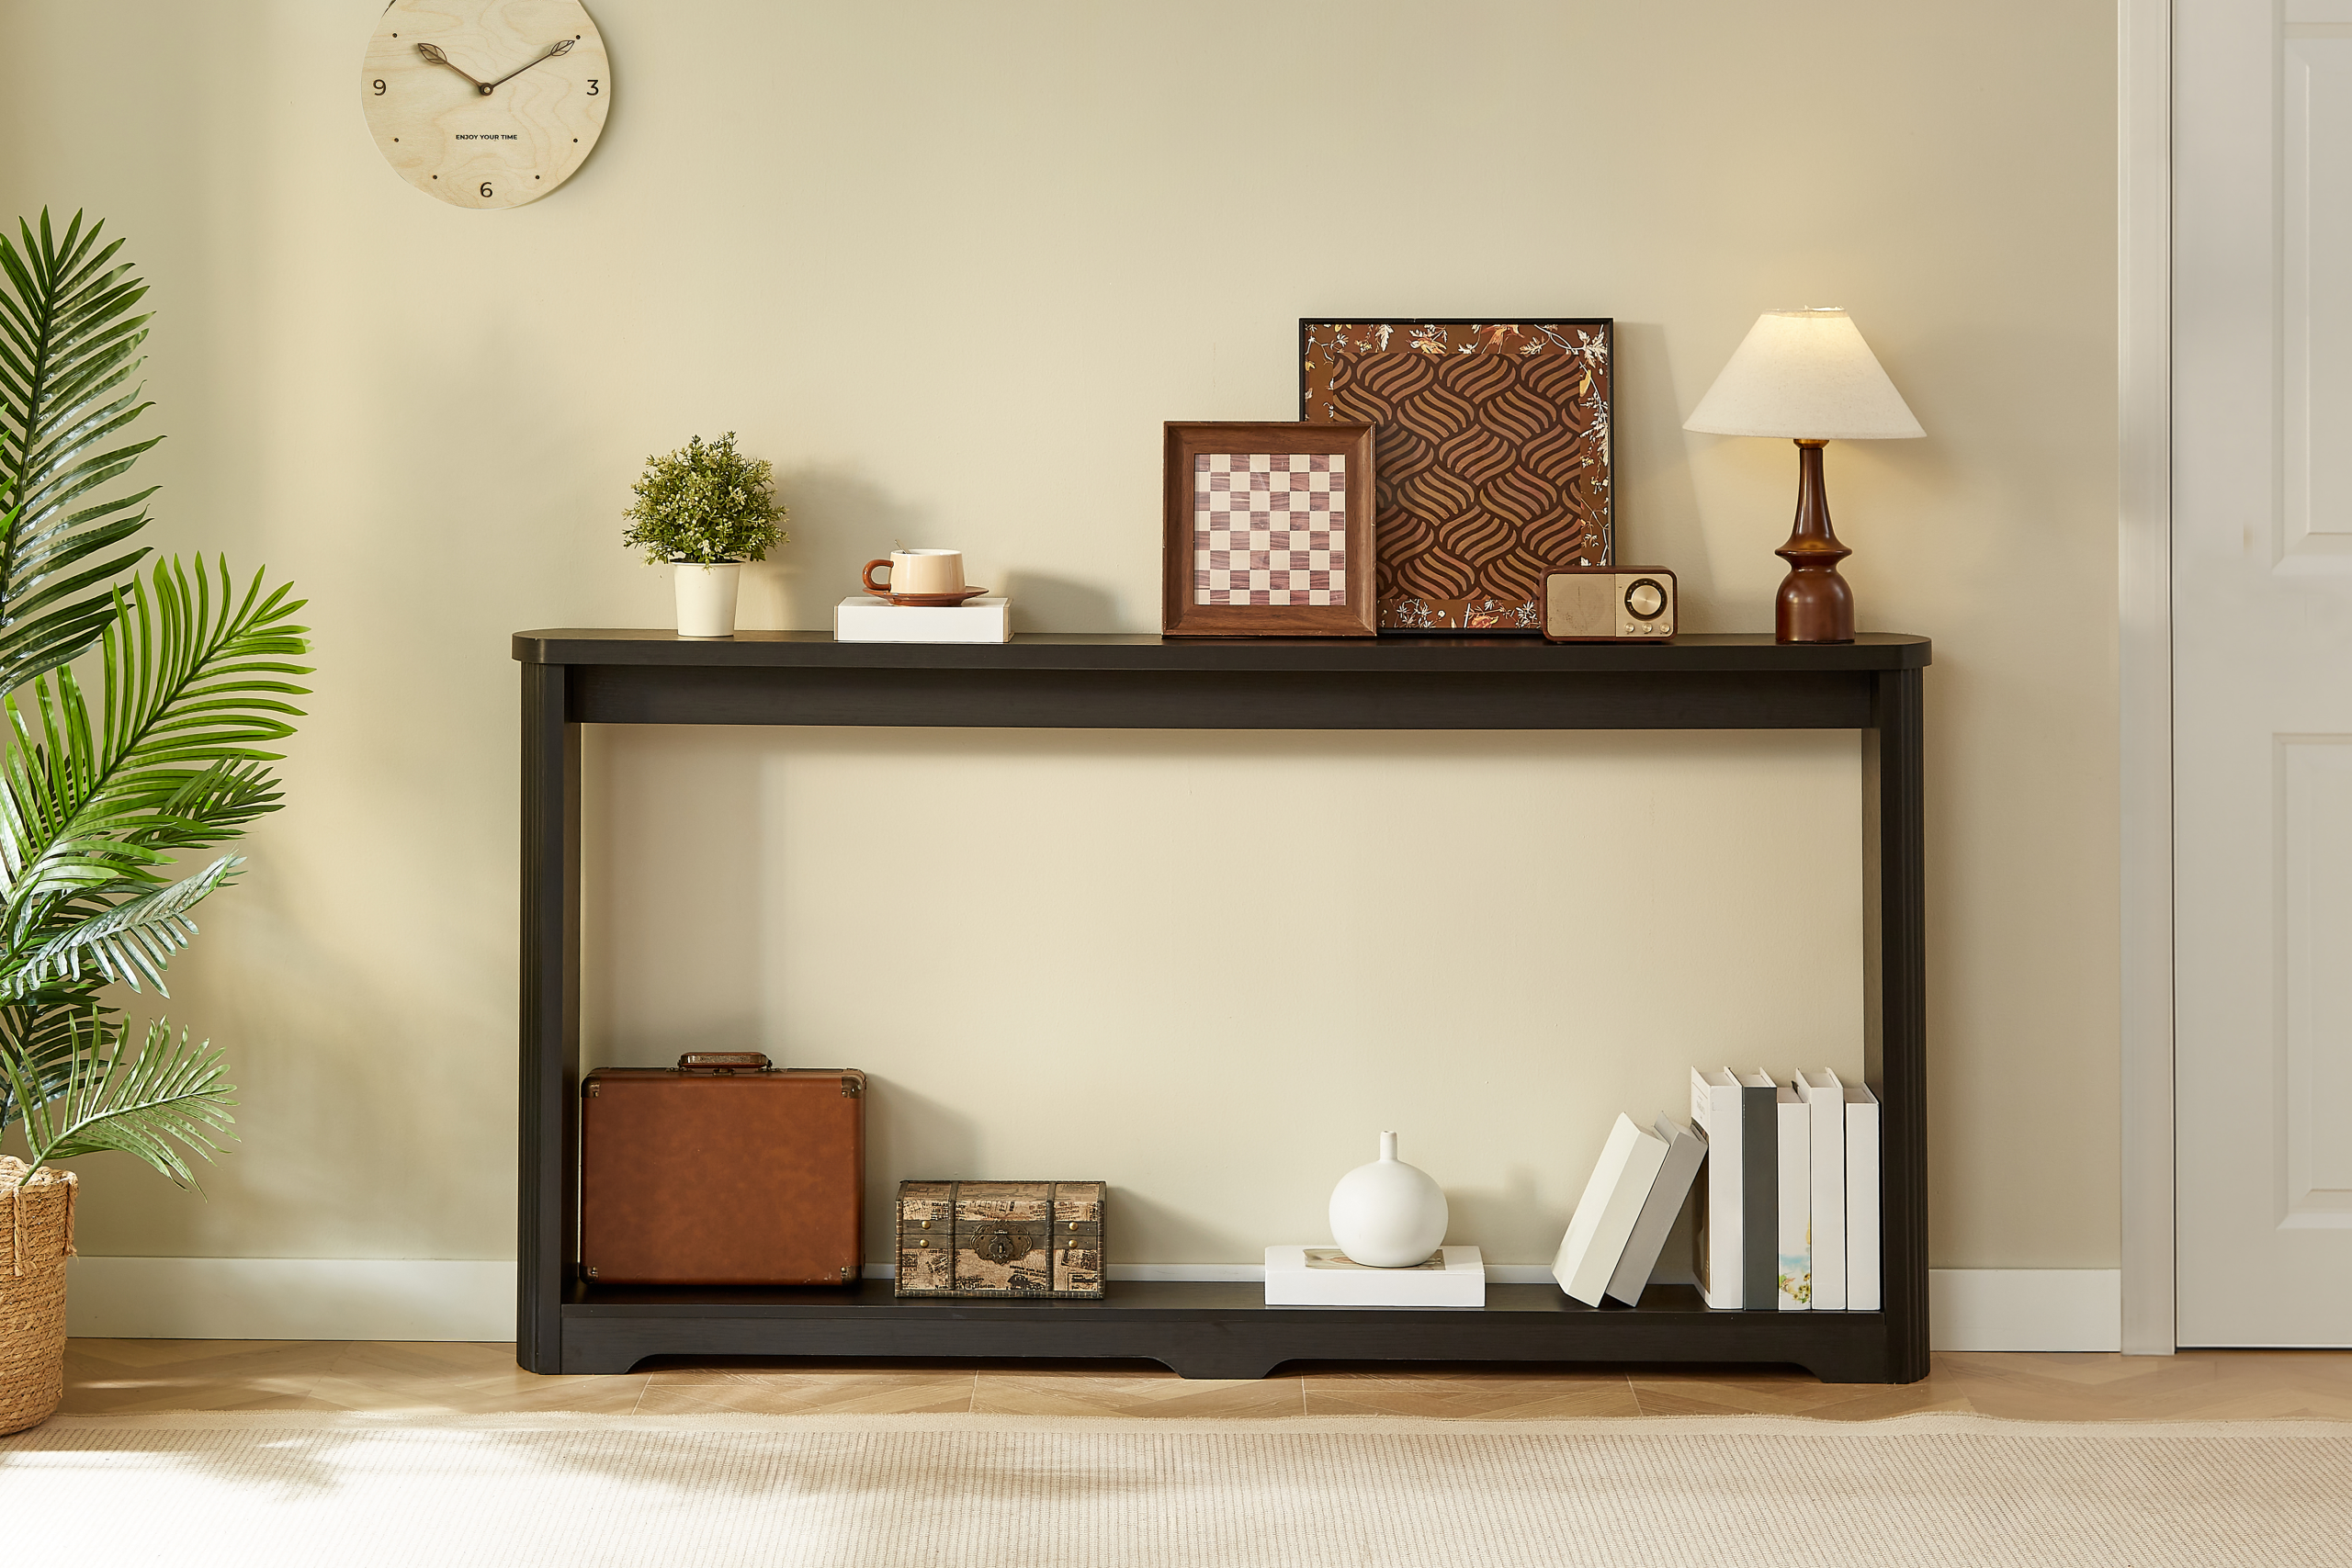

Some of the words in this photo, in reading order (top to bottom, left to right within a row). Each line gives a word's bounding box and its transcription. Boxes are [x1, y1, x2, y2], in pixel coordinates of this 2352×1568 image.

[372, 79, 387, 96] 9
[586, 79, 599, 96] 3
[480, 182, 493, 197] 6
